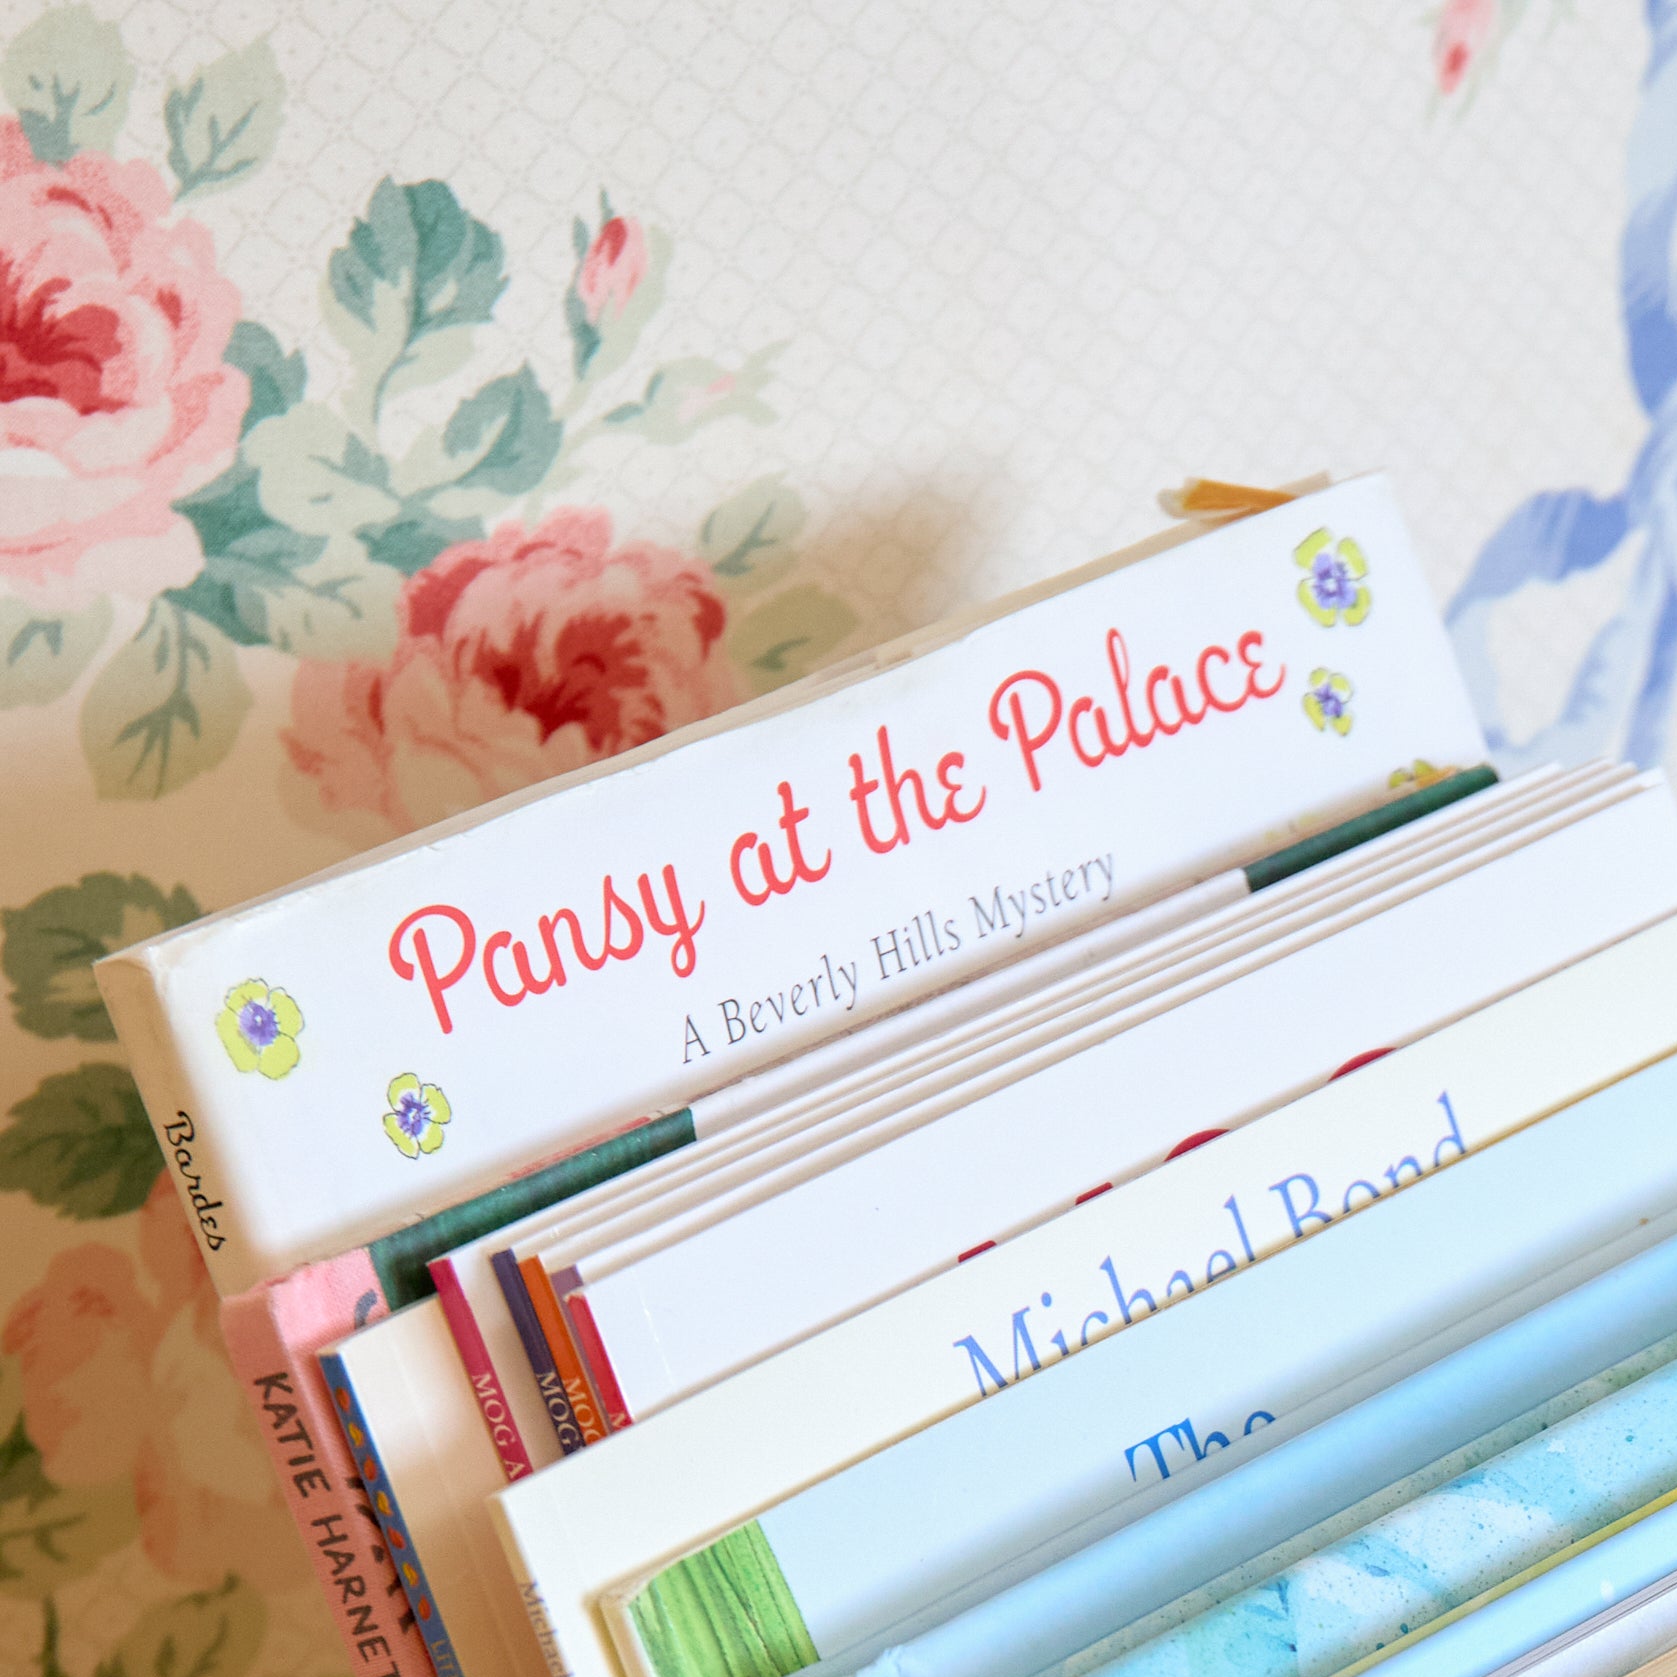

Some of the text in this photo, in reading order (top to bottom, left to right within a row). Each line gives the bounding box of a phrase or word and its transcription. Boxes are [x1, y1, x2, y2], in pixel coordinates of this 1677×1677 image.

[389, 628, 1287, 1034] Pansy at the Palace
[682, 852, 1117, 1065] A Beverly Hills Mystery
[164, 1110, 228, 1253] Bardes
[253, 1371, 331, 1499] KATIE
[472, 1372, 516, 1448] MOG
[536, 1371, 581, 1446] MOG
